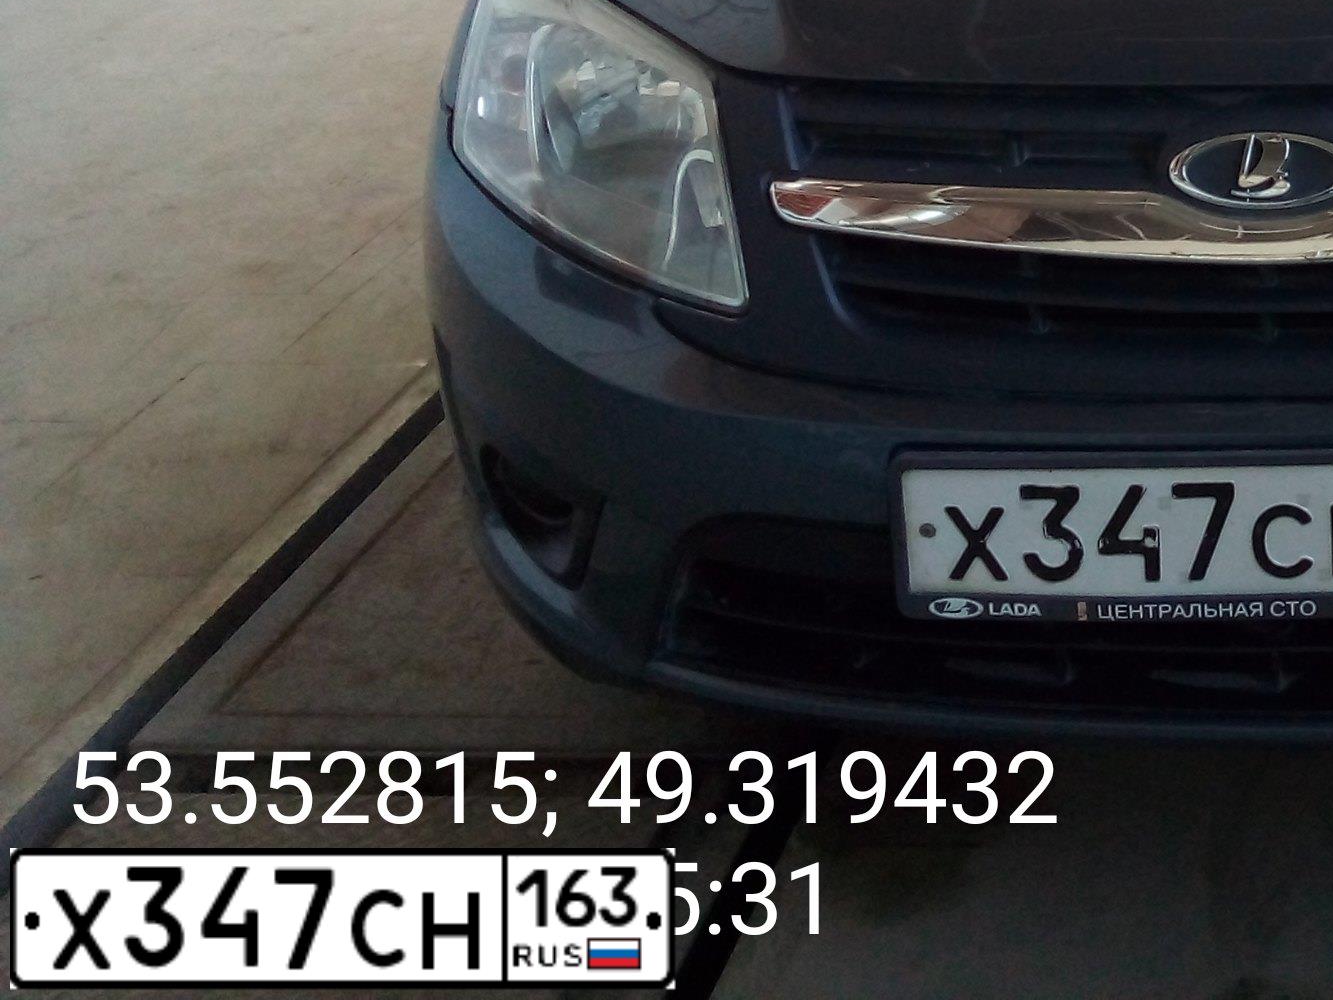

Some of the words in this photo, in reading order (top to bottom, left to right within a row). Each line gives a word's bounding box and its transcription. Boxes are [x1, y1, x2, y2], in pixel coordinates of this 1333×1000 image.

[988, 602, 1042, 617] LADA
[1097, 601, 1264, 621] ЦЕНТРАЛЬНАЯ
[1270, 600, 1317, 617] СТО
